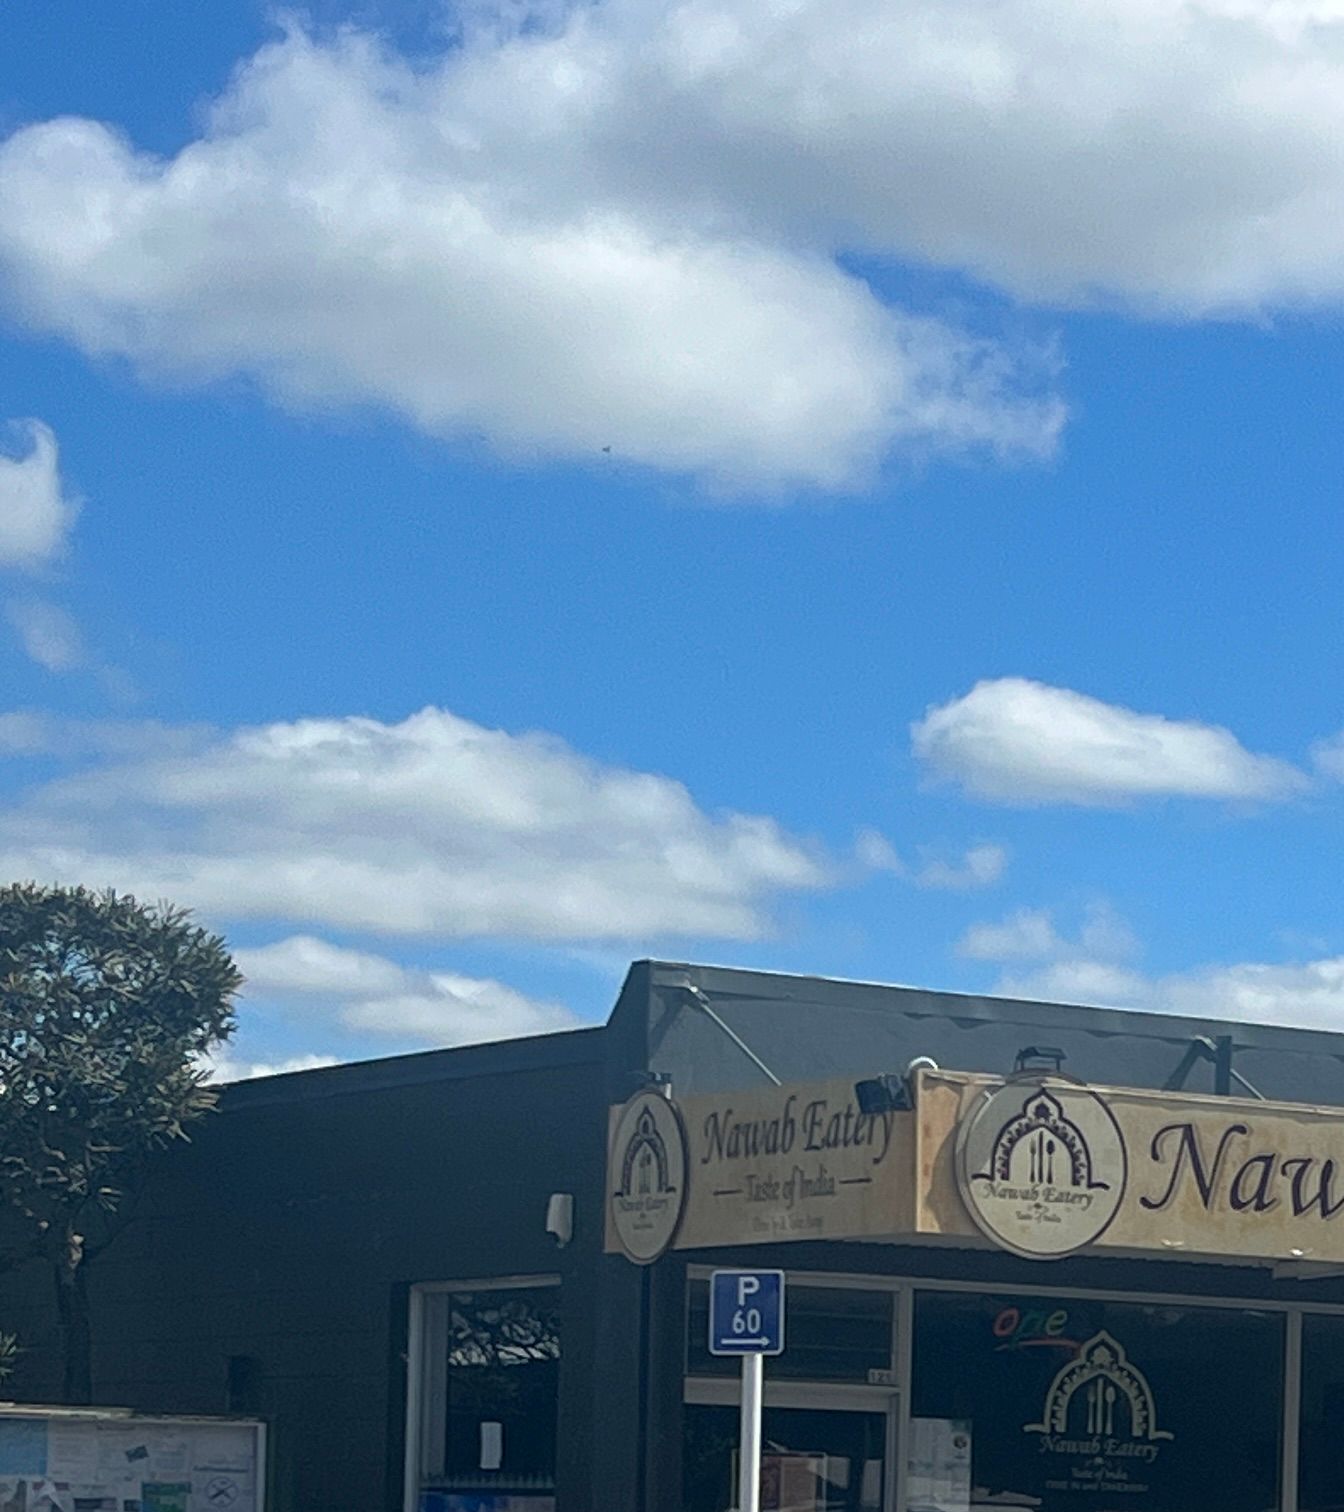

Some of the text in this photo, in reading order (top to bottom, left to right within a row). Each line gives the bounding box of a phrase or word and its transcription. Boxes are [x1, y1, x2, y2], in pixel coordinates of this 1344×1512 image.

[702, 1095, 894, 1165] Nawab Eatery
[737, 1276, 761, 1306] P
[732, 1308, 761, 1335] 60
